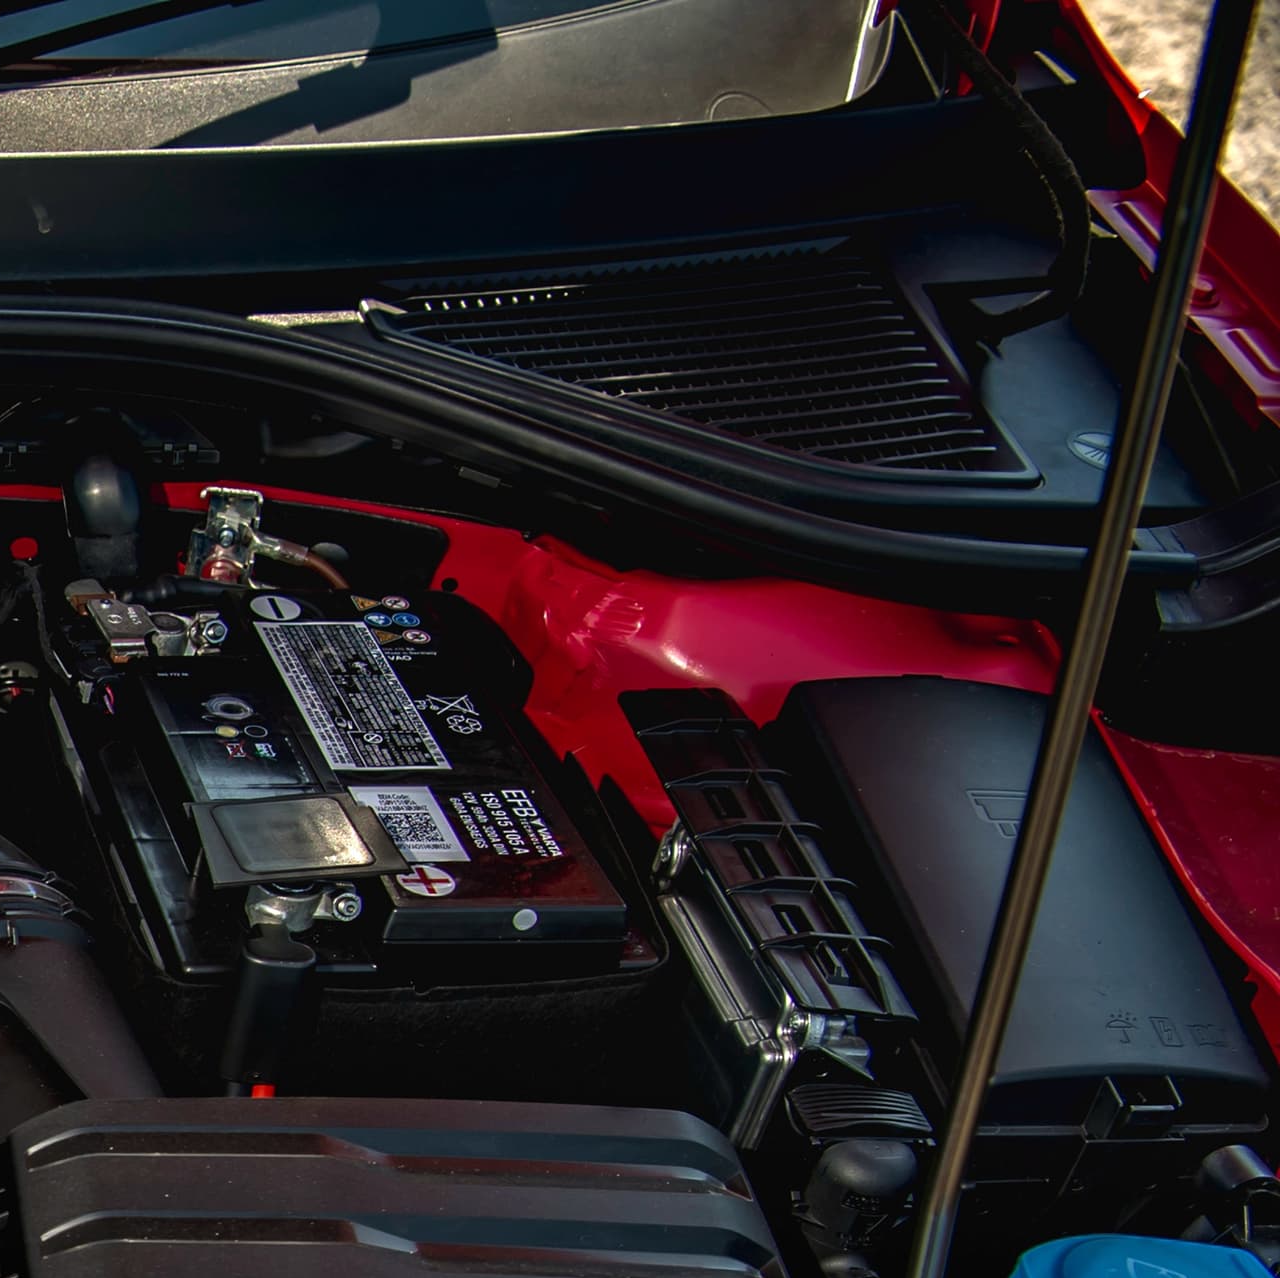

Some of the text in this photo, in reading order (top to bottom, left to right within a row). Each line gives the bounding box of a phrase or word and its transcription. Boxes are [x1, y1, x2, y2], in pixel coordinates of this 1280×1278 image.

[491, 810, 514, 827] 915
[501, 789, 564, 857] EFB VARTA
[502, 829, 525, 846] 105
[512, 847, 530, 855] A
